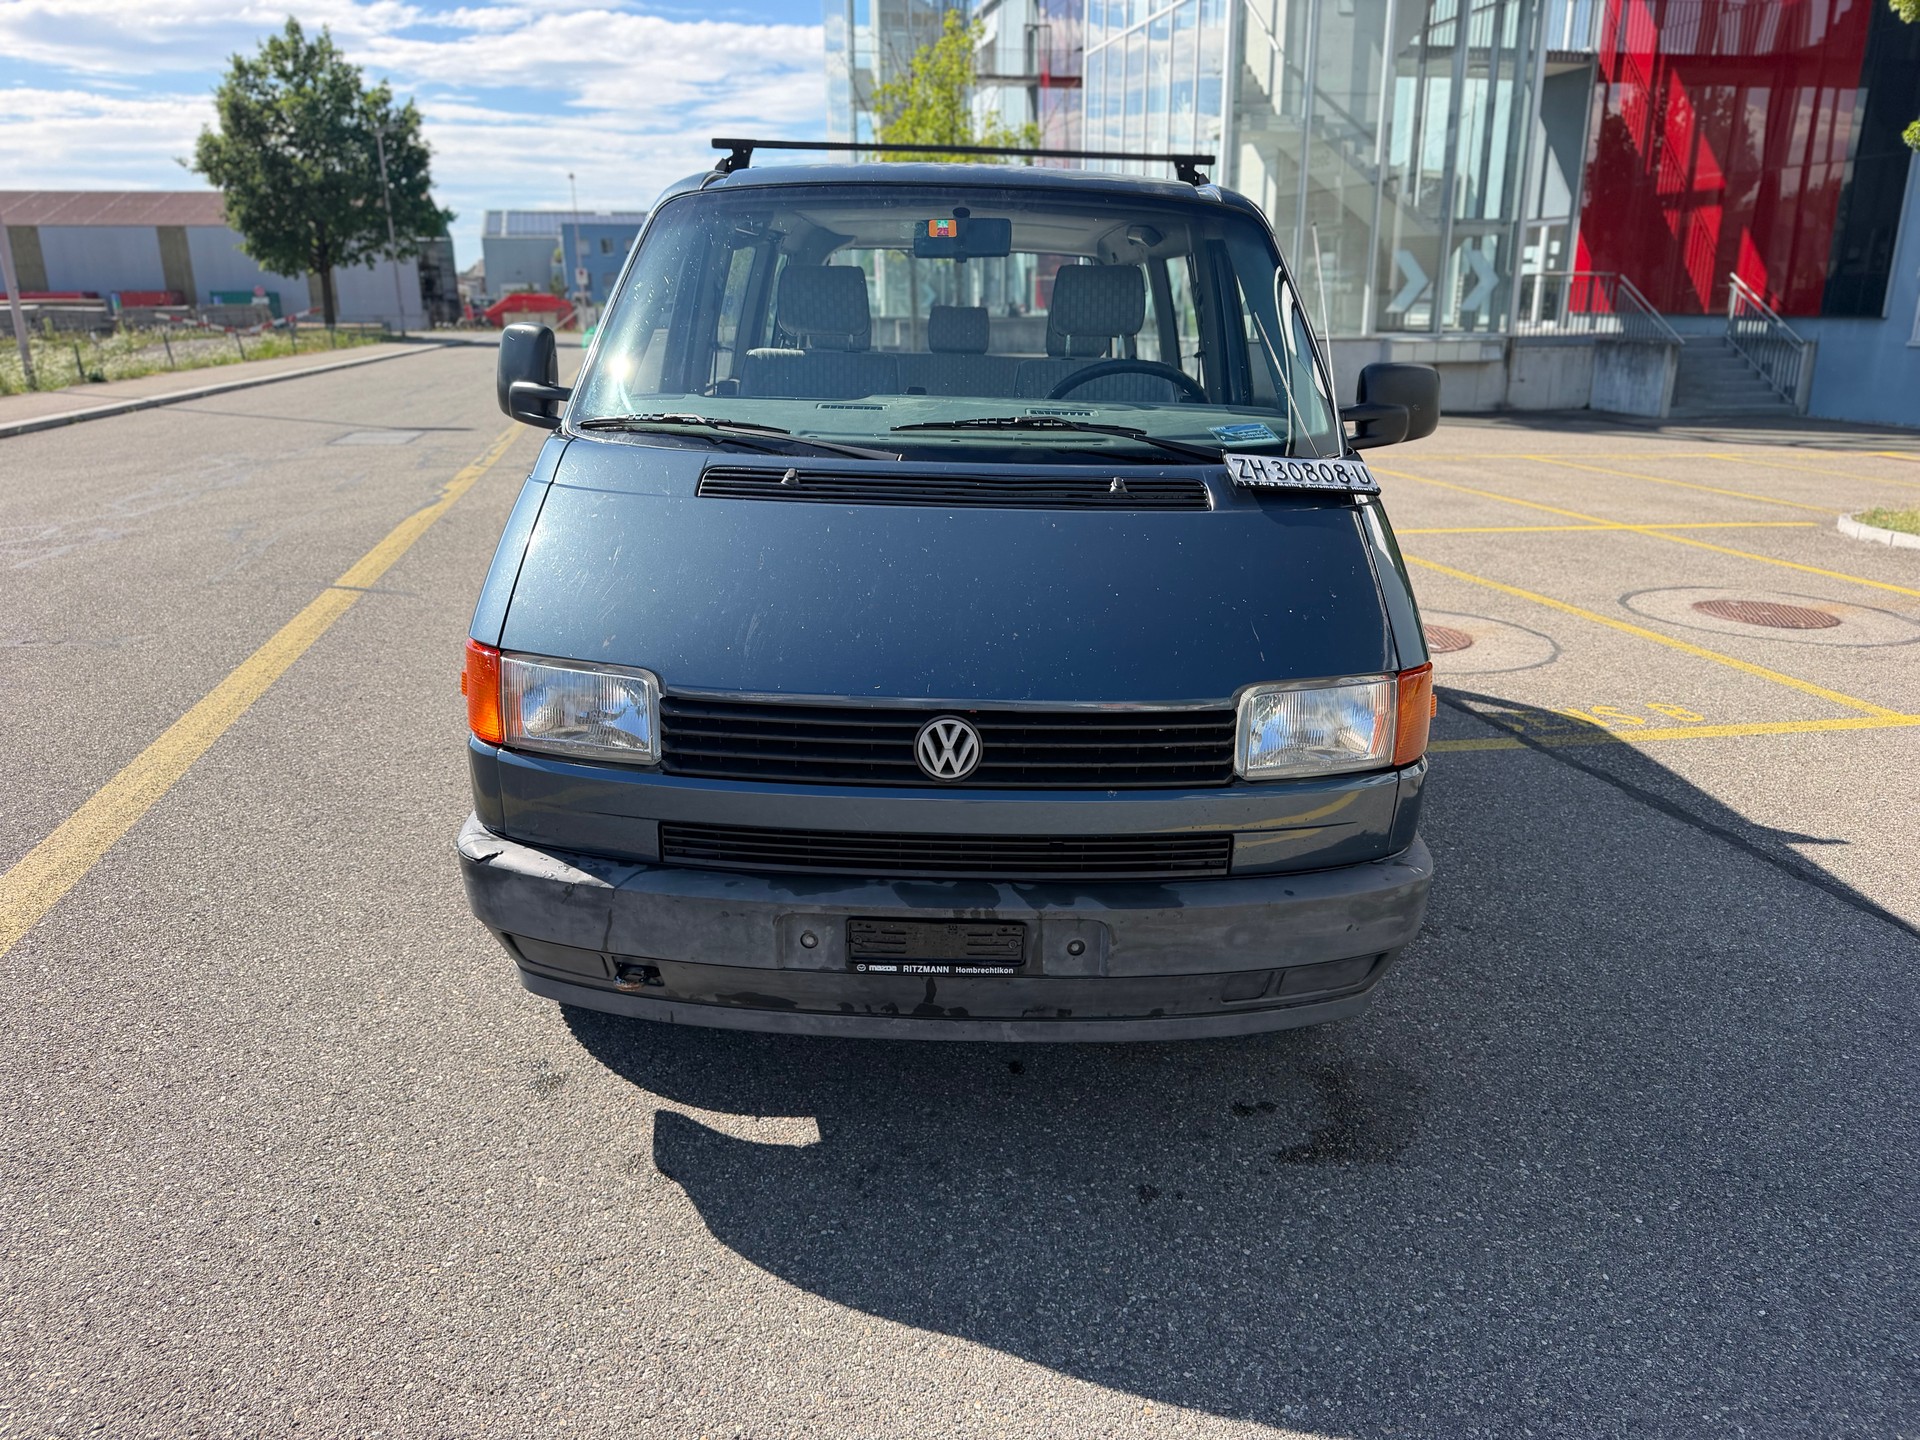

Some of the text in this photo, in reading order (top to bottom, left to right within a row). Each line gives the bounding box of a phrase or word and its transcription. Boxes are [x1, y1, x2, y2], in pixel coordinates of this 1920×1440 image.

[918, 719, 979, 779] VW
[868, 964, 1014, 975] mazda RITZMANN Hombrechtikon
